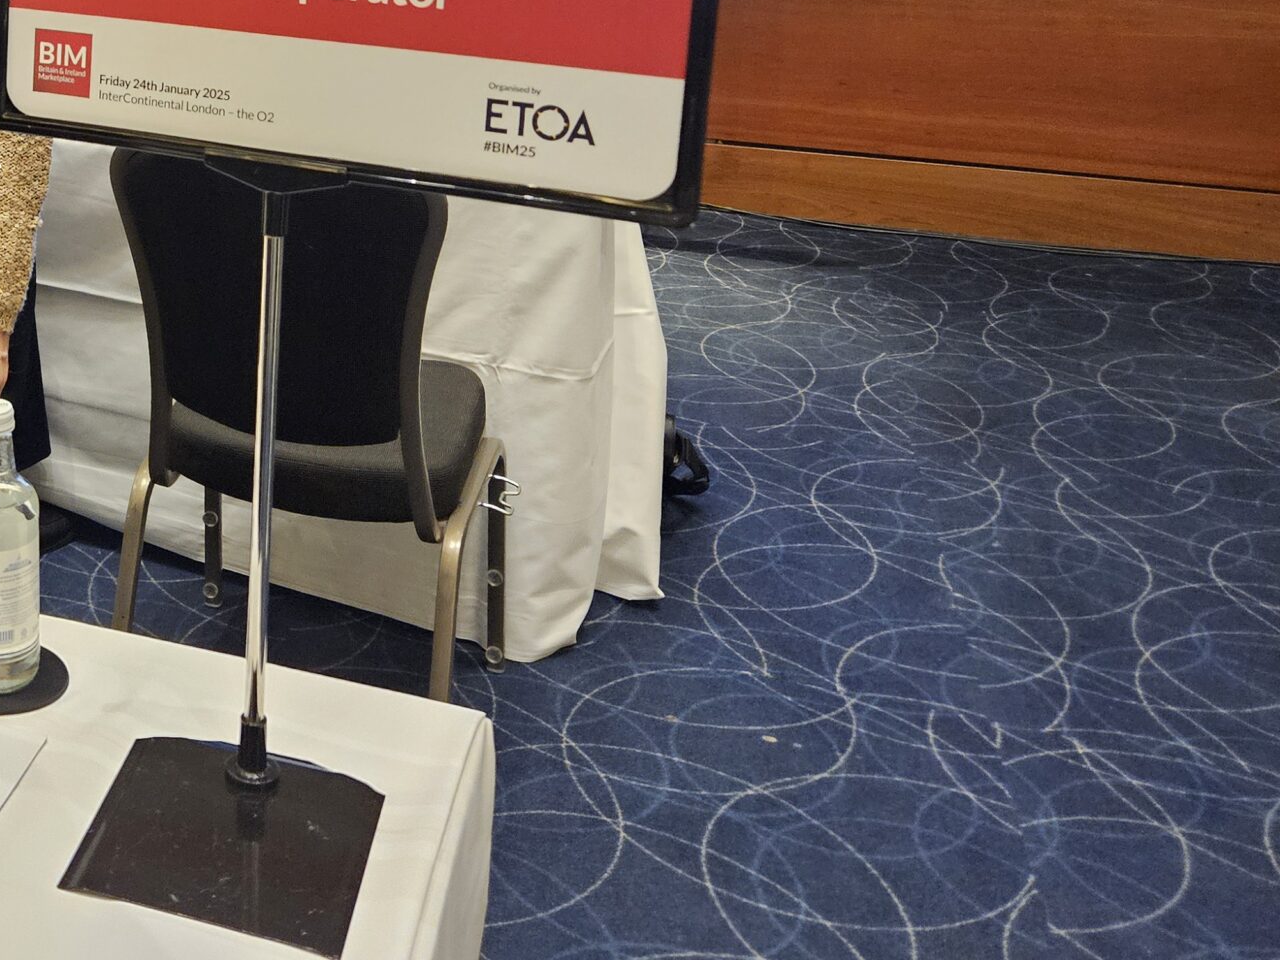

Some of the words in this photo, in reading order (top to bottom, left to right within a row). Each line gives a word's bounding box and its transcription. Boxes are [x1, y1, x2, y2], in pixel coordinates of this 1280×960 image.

[39, 41, 87, 69] BIM
[99, 74, 131, 89] Friday
[133, 78, 158, 91] 24th
[159, 82, 200, 98] January
[202, 88, 230, 101] 2025
[488, 81, 530, 93] Organised
[531, 87, 541, 96] by
[98, 90, 184, 110] InterContinental
[186, 101, 226, 117] London
[236, 108, 254, 120] the
[257, 111, 274, 123] O2
[485, 98, 595, 146] ETOA
[483, 141, 536, 158] #BIM25
